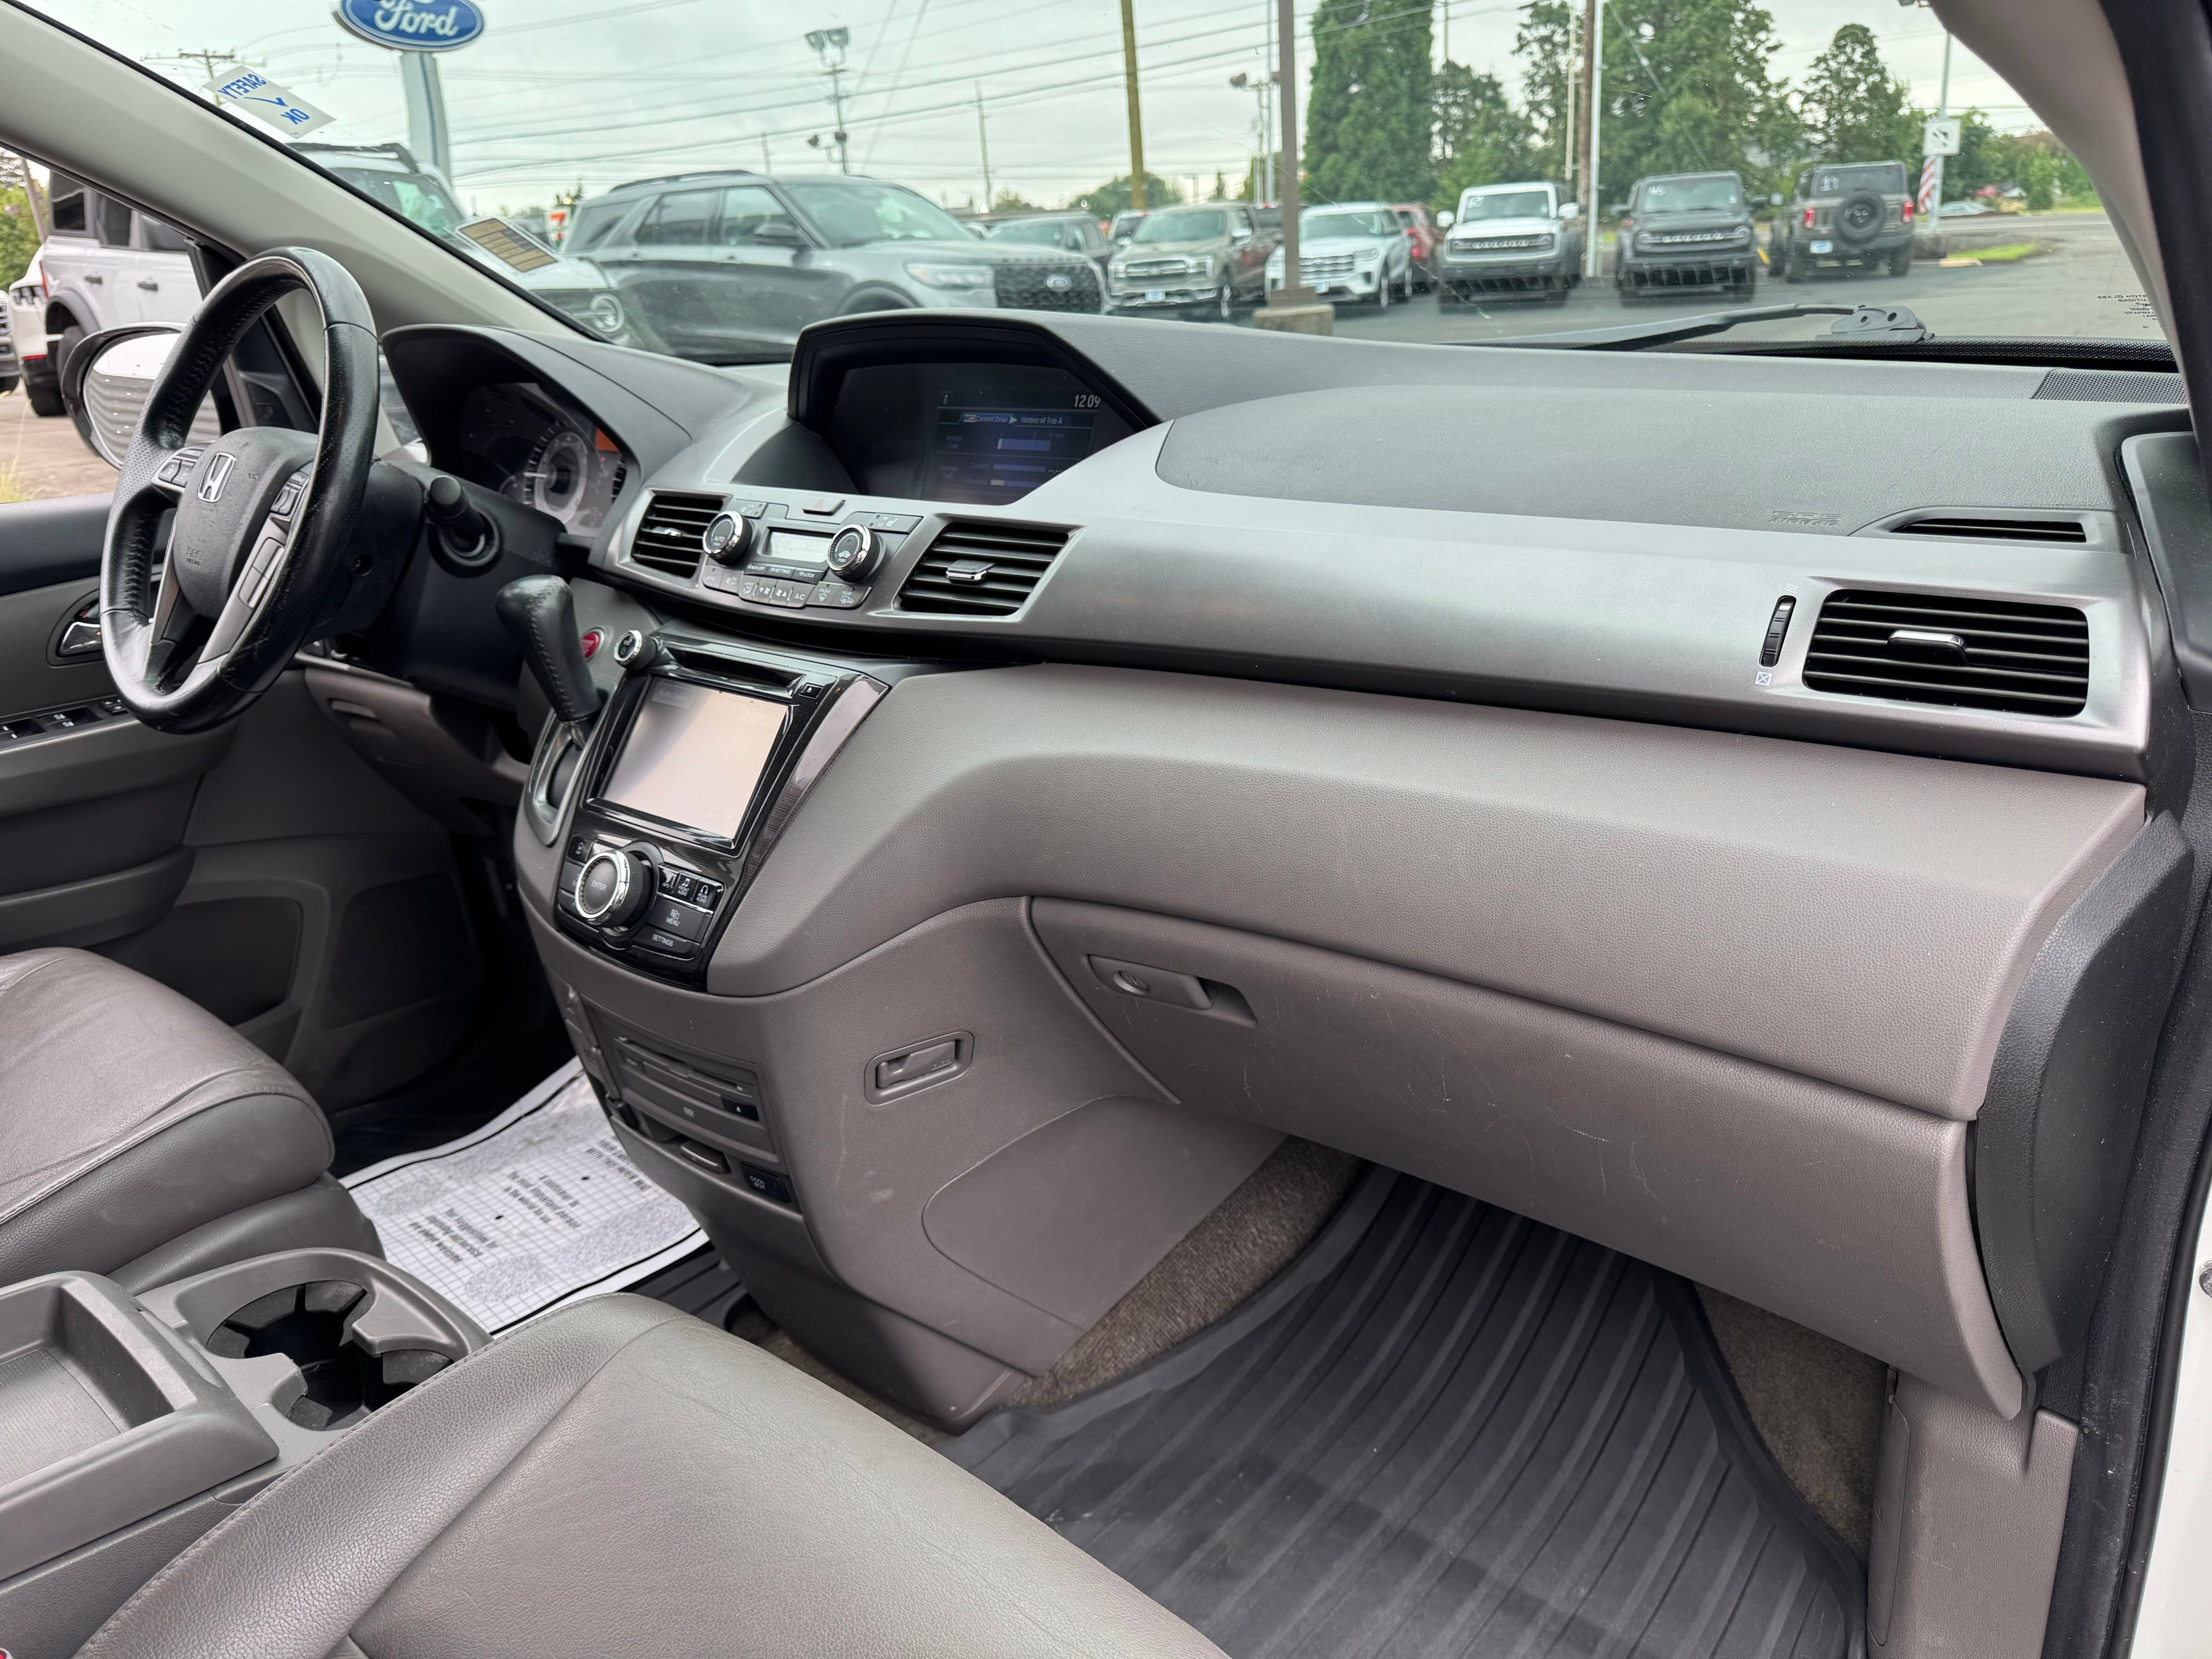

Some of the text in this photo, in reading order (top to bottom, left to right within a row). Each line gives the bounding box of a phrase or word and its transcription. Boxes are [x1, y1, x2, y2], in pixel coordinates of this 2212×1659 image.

[374, 0, 459, 37] Ford
[1020, 416, 1040, 425] History
[1047, 417, 1058, 425] Trip
[591, 880, 607, 891] ENTER
[666, 917, 680, 927] MENU
[652, 934, 674, 947] SETTINGS
